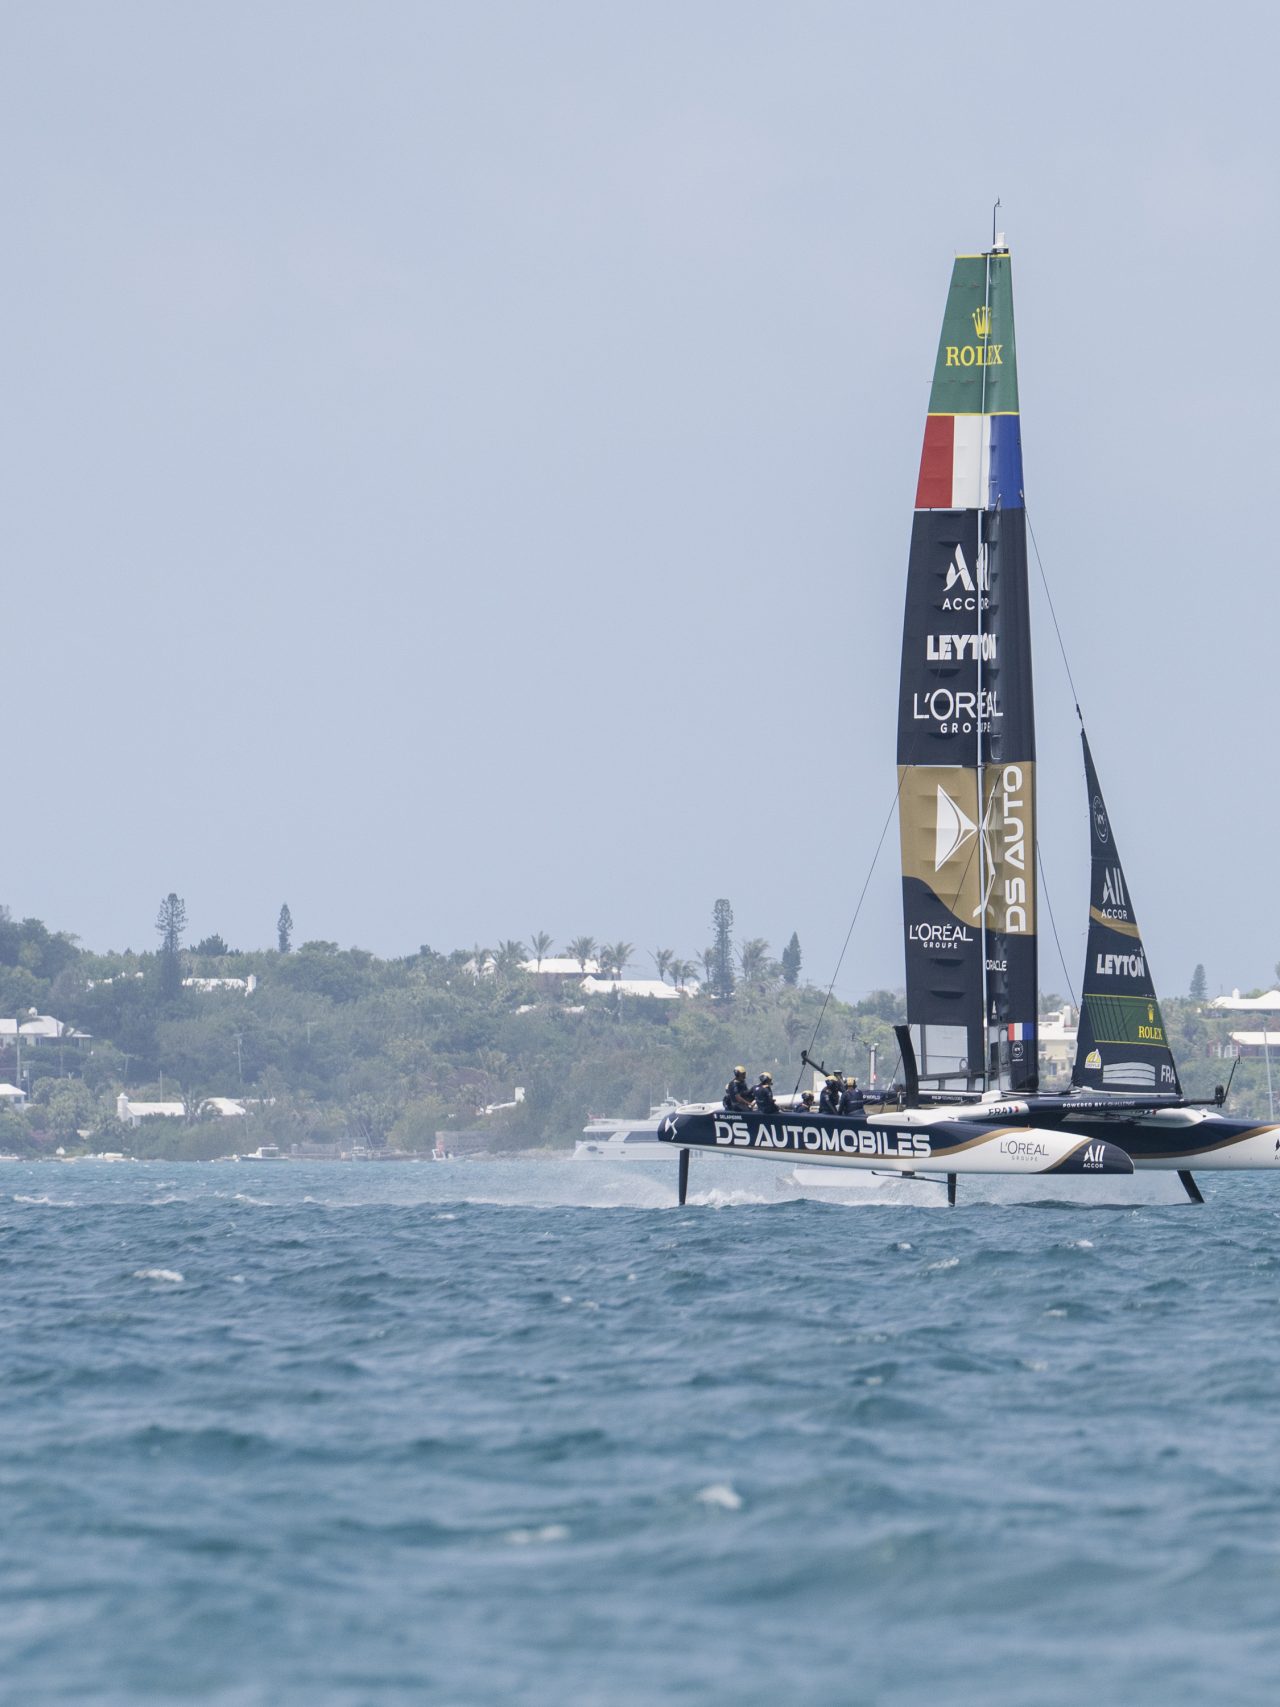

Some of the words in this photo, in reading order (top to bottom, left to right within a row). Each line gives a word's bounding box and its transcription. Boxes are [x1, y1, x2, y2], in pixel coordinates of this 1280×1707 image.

[945, 344, 1003, 366] ROLEX
[926, 632, 997, 661] LEYTON
[1003, 765, 1025, 870] AUTO
[1004, 877, 1026, 933] DS
[1101, 909, 1128, 920] ACCOR
[909, 922, 973, 942] L'ORÉAL
[923, 941, 958, 949] GROUPE
[986, 959, 1008, 972] ORACLE
[1095, 954, 1145, 978] LEYTON
[1138, 1025, 1163, 1040] ROLEX
[1160, 1064, 1177, 1084] FRA
[988, 1106, 1008, 1116] FRA
[714, 1121, 750, 1145] DS
[754, 1123, 932, 1158] AUTOMOBILES
[1000, 1140, 1049, 1156] L'ORÉAL
